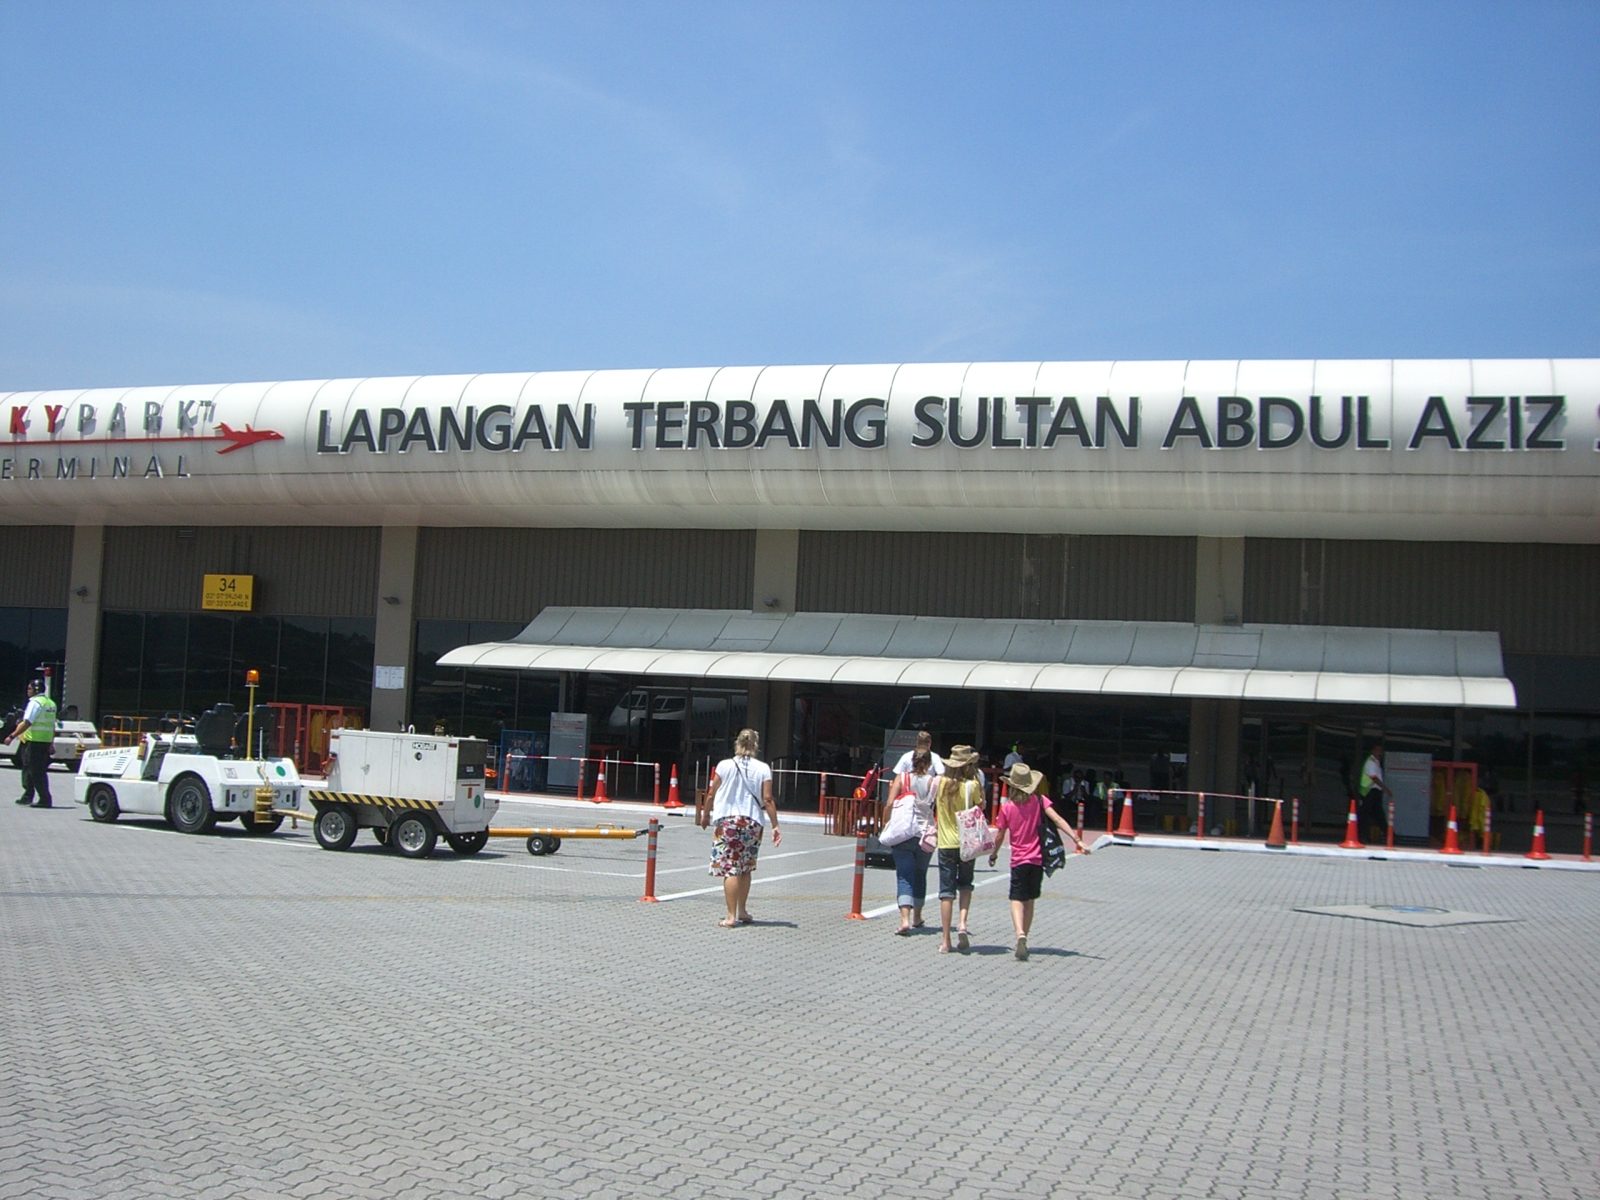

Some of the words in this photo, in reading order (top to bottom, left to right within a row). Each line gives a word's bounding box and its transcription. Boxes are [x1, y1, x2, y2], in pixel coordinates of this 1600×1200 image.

[317, 403, 593, 454] LAPANGAN
[623, 398, 887, 449] TERBANG
[911, 396, 1140, 448] SULTAN
[1161, 395, 1391, 450] ABDUL
[1407, 396, 1567, 450] AZIZ
[1, 455, 190, 479] ERMINAL
[219, 577, 236, 592] 34
